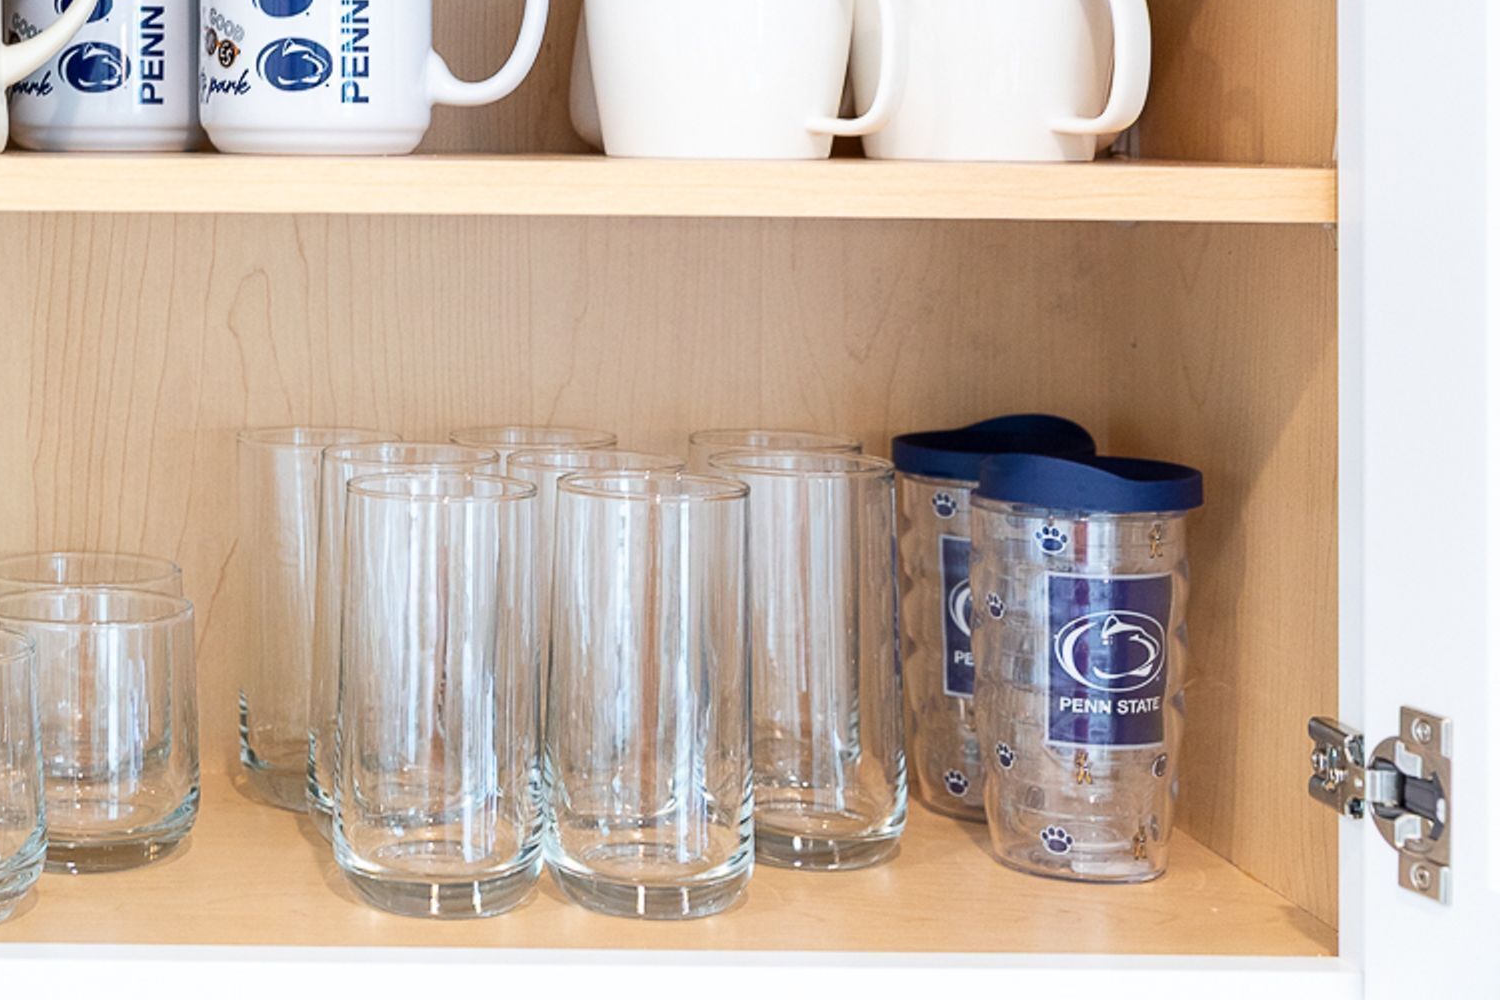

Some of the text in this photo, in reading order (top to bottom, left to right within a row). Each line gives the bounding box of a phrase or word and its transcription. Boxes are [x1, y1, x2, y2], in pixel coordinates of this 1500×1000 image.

[12, 12, 43, 39] GOO
[139, 5, 165, 105] PENN
[341, 0, 369, 104] PENN
[1059, 695, 1162, 716] PENN STATE
